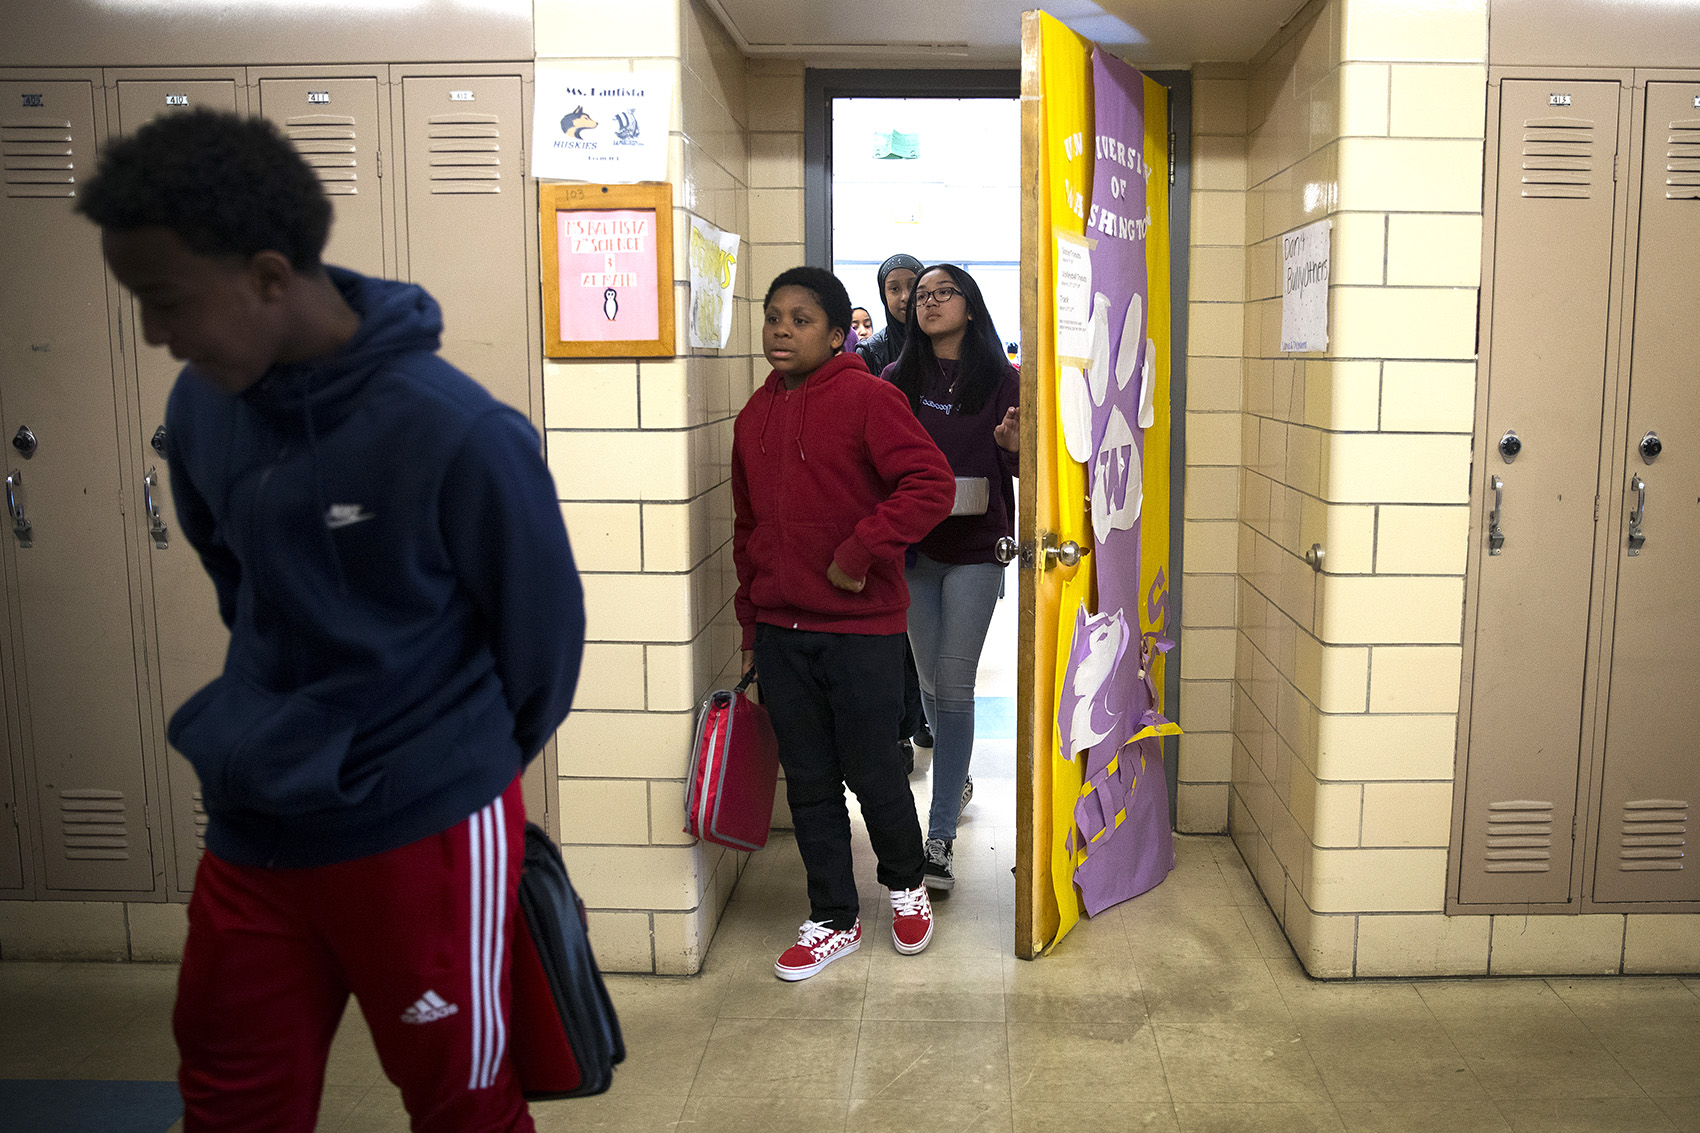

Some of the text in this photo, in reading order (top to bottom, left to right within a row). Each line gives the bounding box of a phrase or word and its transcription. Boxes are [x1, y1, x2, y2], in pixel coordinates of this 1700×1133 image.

[553, 140, 598, 150] HUSKIES
[1110, 176, 1127, 199] OF
[565, 189, 584, 200] 103
